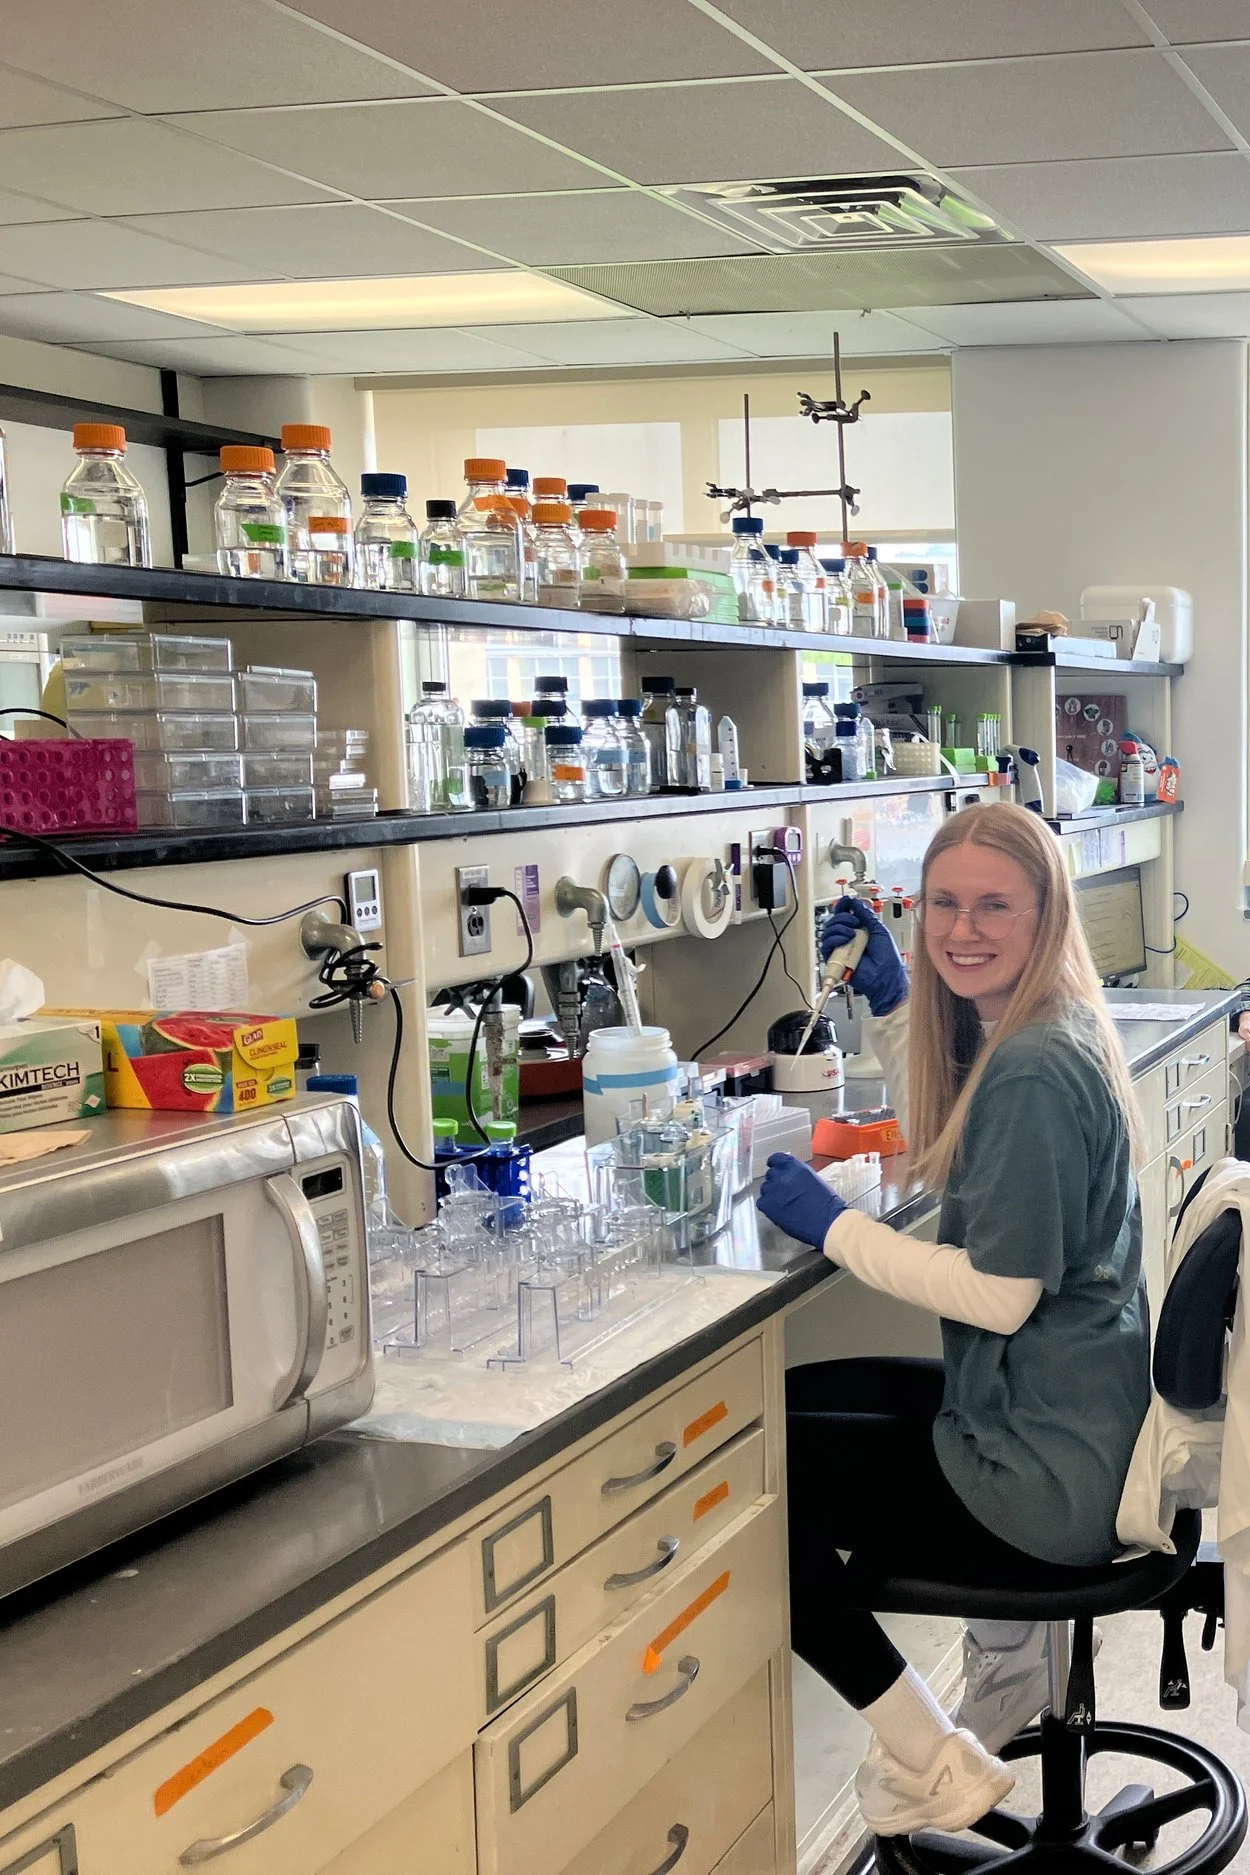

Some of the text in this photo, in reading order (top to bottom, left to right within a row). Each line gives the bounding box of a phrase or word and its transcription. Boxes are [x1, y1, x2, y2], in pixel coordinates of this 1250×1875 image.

[243, 1029, 263, 1046] GLAD
[184, 1073, 196, 1082] 2X
[238, 1088, 257, 1102] 400
